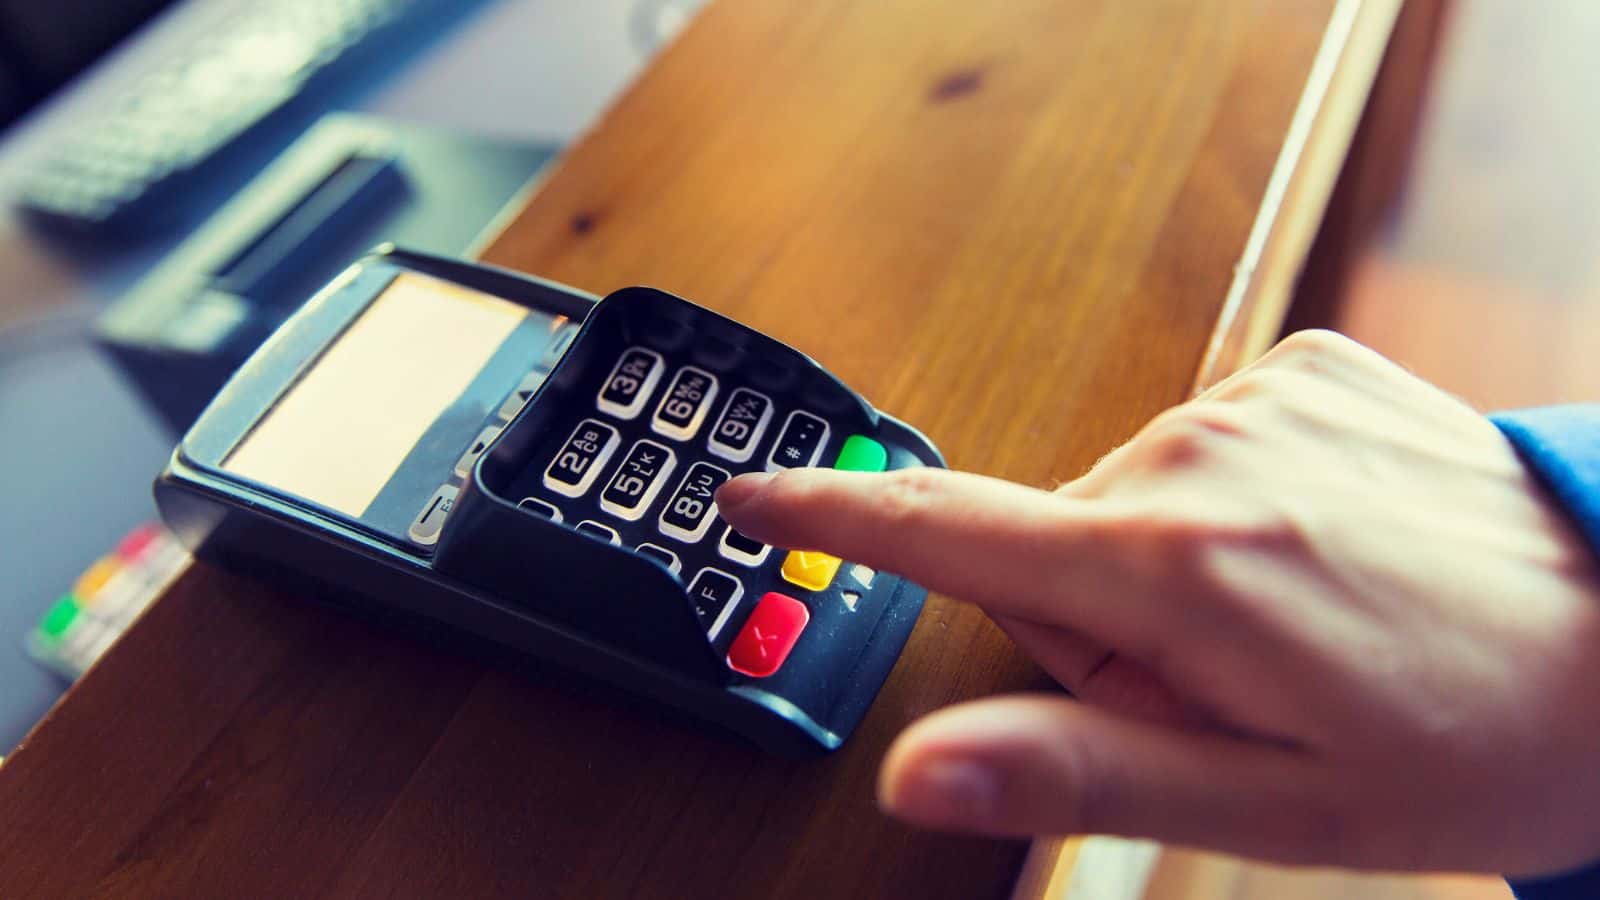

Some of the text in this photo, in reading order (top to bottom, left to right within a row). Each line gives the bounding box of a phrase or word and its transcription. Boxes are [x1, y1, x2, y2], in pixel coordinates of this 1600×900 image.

[611, 376, 638, 395] 3
[665, 399, 693, 419] 6
[721, 420, 749, 440] 9
[559, 452, 589, 474] 2
[614, 473, 645, 497] 5
[674, 496, 704, 519] 8
[701, 586, 717, 601] F
